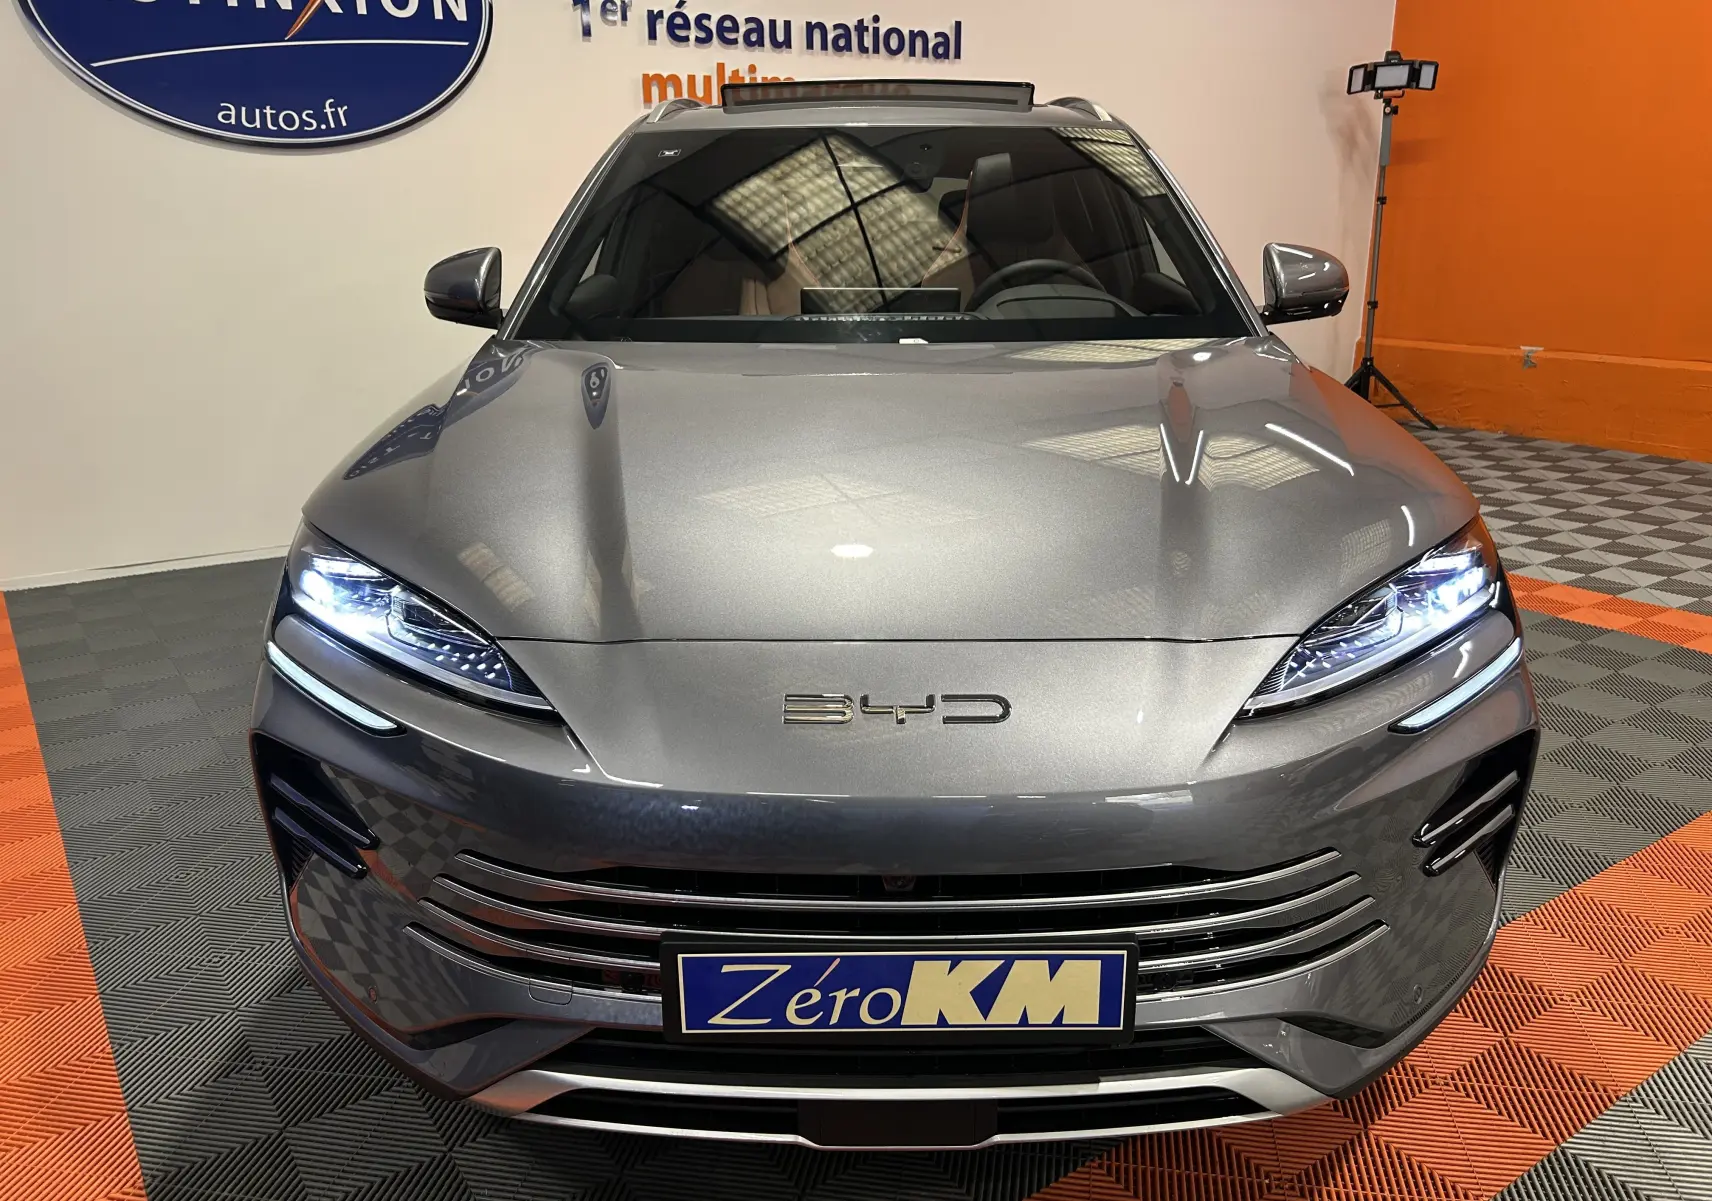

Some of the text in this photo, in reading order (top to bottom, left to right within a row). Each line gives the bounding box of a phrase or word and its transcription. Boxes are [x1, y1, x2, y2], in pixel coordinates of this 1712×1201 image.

[646, 1, 792, 49] réseau
[805, 15, 962, 60] national
[217, 98, 349, 131] autos.fr
[783, 693, 1012, 724] BYD
